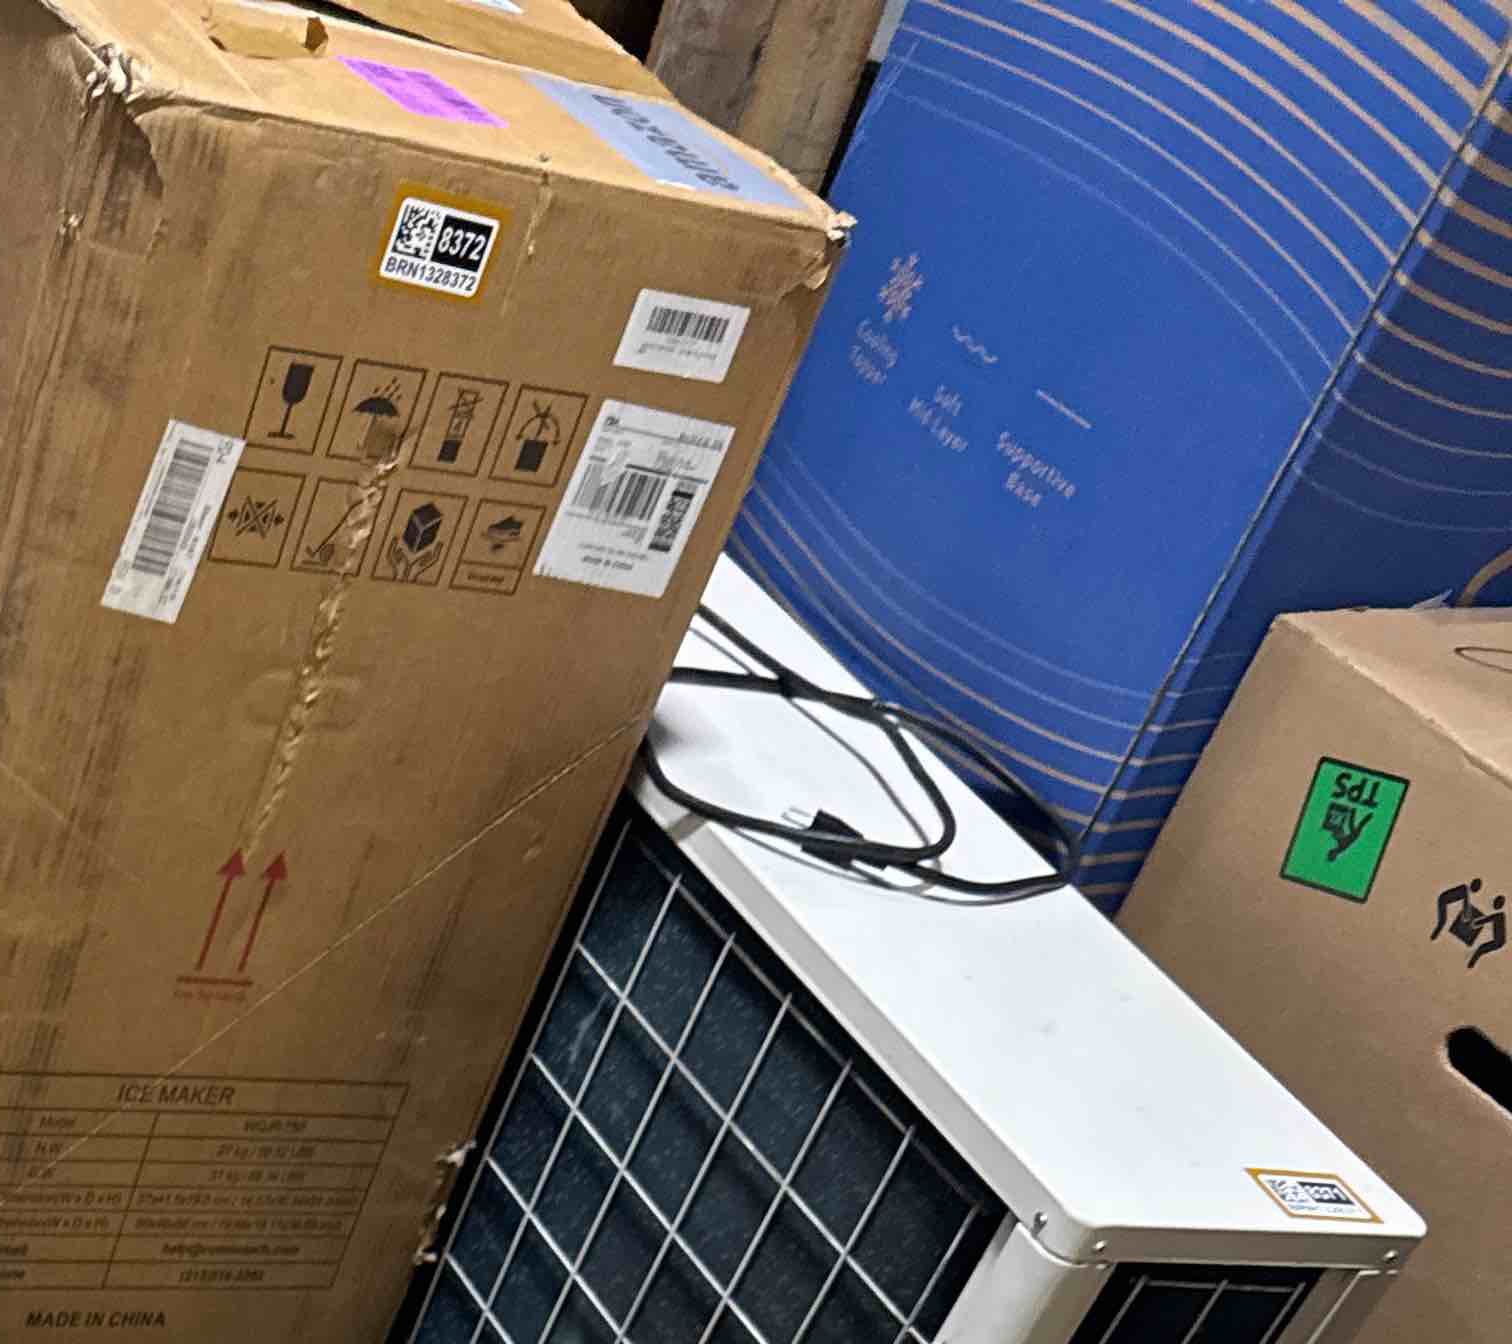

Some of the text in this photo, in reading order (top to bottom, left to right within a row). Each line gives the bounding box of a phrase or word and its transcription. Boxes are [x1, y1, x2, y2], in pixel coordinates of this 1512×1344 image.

[437, 226, 486, 261] 8372
[385, 255, 477, 292] BRN1328372
[117, 1083, 236, 1106] ICE MAKER
[24, 1311, 167, 1328] MADE IN CHINA
